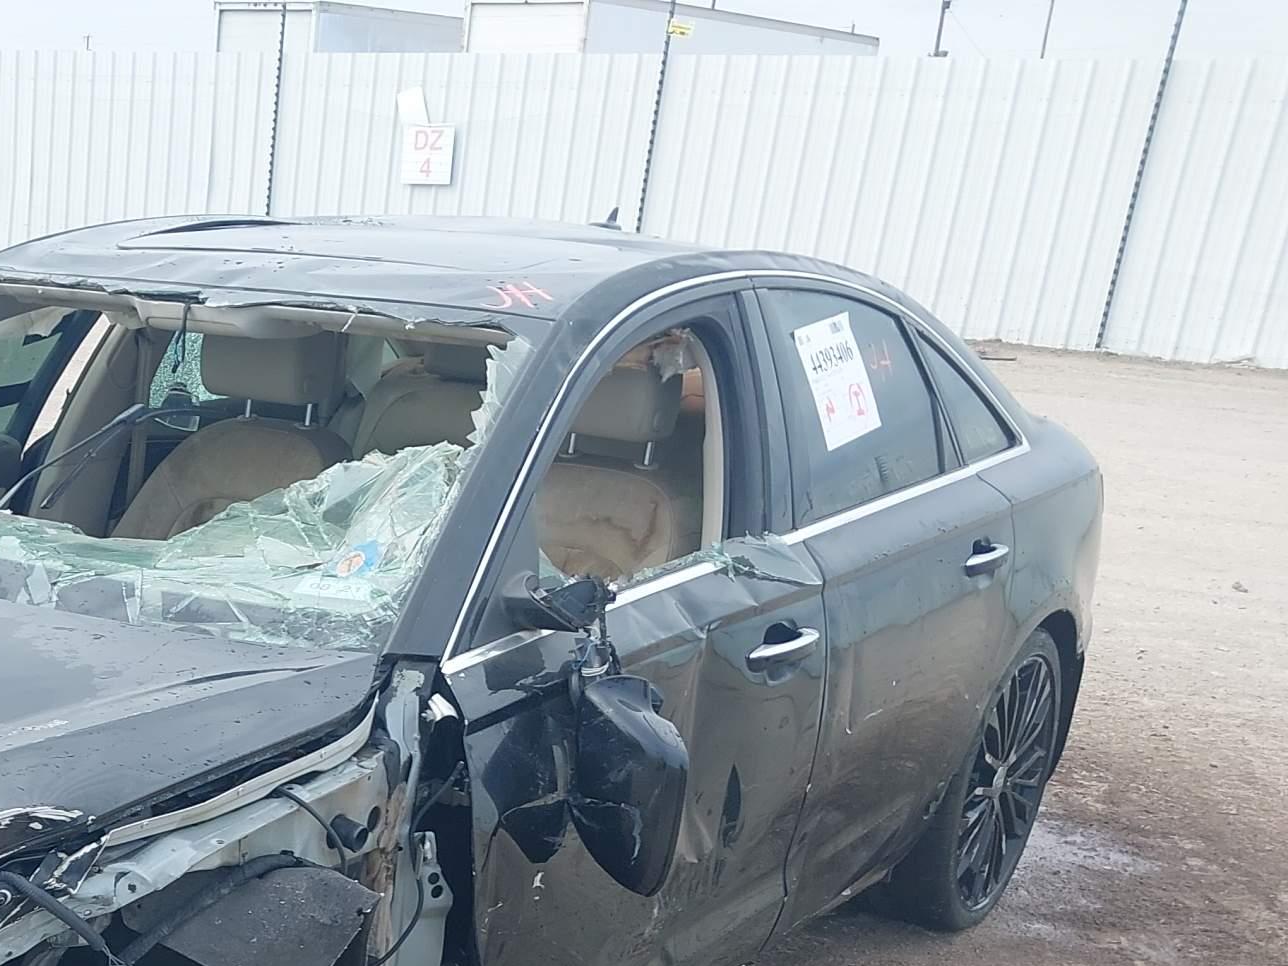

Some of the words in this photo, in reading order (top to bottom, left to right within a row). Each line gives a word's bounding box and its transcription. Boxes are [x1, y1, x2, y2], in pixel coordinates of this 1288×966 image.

[414, 129, 445, 151] DZ
[419, 157, 432, 178] 4
[810, 340, 854, 375] 44393406
